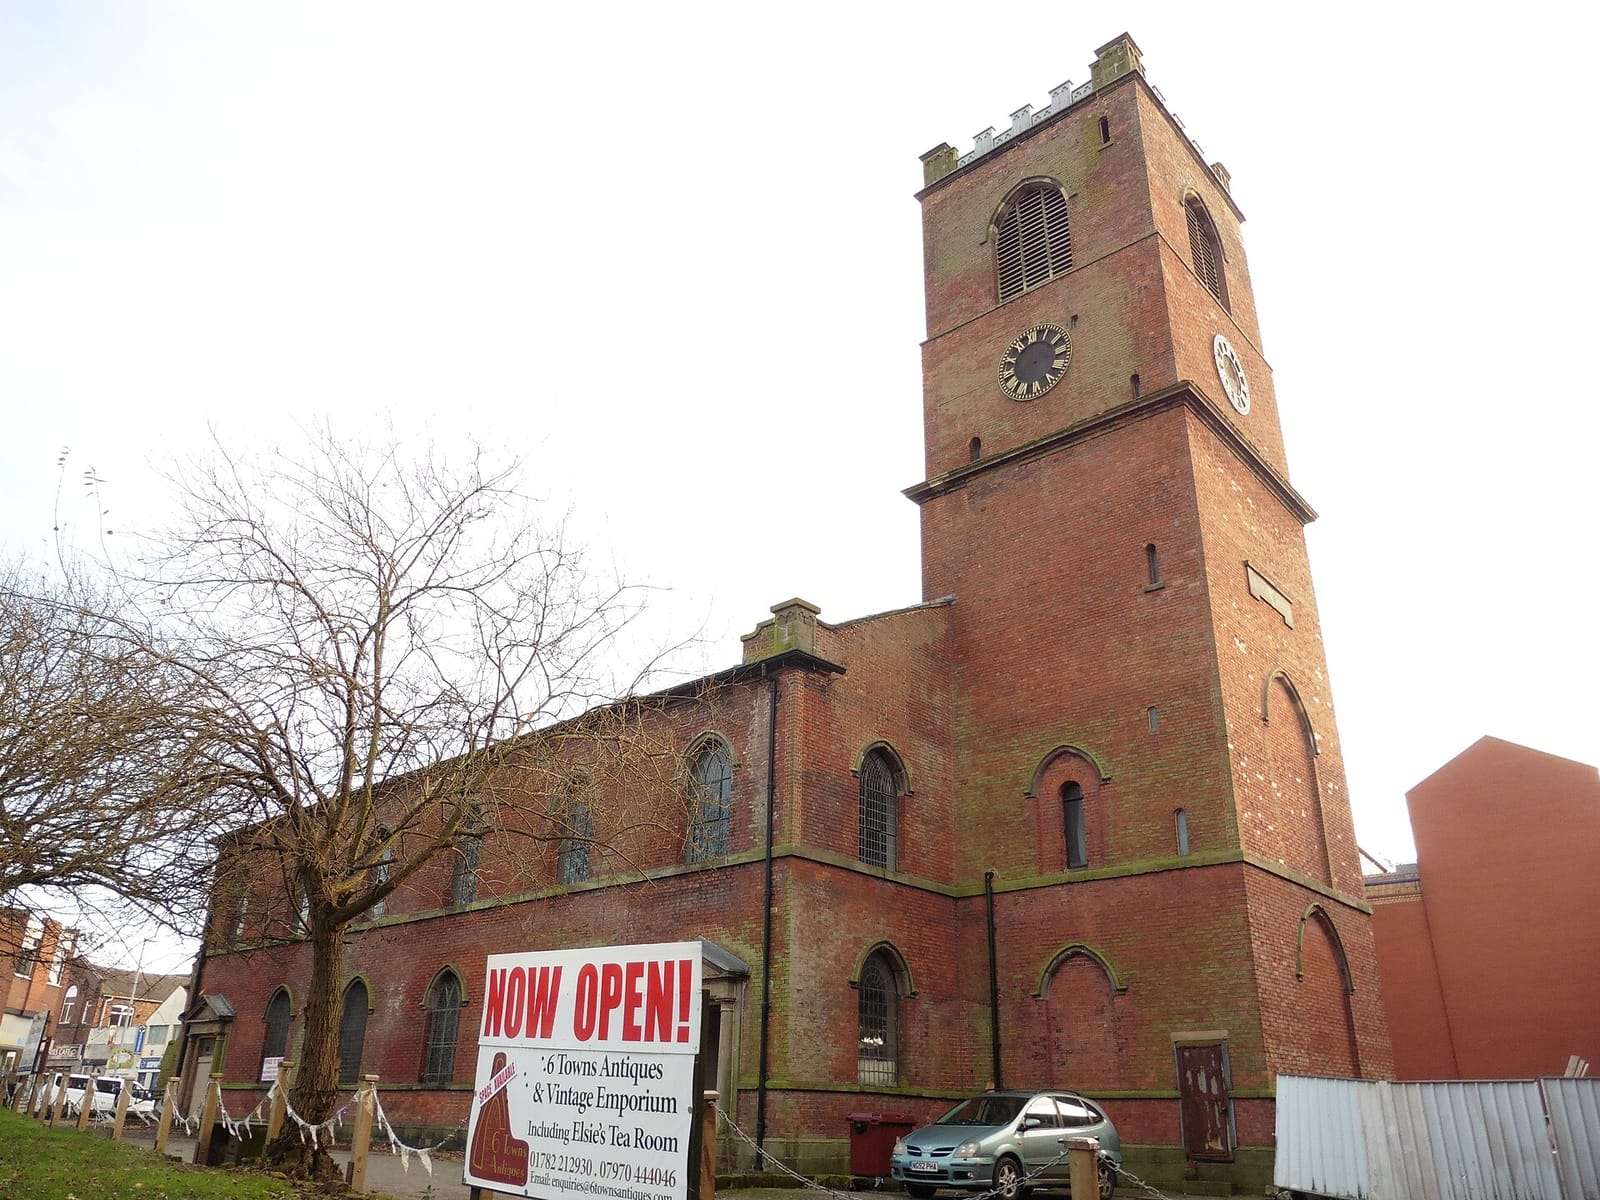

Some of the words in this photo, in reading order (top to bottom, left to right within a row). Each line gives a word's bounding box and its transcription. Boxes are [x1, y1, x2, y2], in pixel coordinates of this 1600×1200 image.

[483, 966, 563, 1039] NOW
[573, 959, 693, 1043] OPEN!
[479, 1082, 492, 1104] SPACE
[494, 1062, 516, 1092] AVAILABLE
[547, 1054, 555, 1075] 6
[557, 1053, 598, 1077] Towns
[599, 1055, 664, 1086] Antiques
[532, 1081, 545, 1104] &
[546, 1083, 594, 1114] Vintage
[595, 1086, 678, 1118] Emporium
[491, 1131, 500, 1154] 6
[503, 1133, 527, 1158] Towns
[527, 1120, 571, 1146] Including
[571, 1120, 606, 1145] Elsie's
[608, 1124, 631, 1148] Tea
[633, 1127, 679, 1153] Room
[490, 1154, 524, 1180] Antiques
[530, 1150, 557, 1171] 01782
[558, 1154, 593, 1177] 212930
[599, 1160, 632, 1182] 07970
[633, 1165, 677, 1189] 444046
[530, 1170, 551, 1186] Email:
[551, 1177, 672, 1200] enquiries@6townsantiquescom
